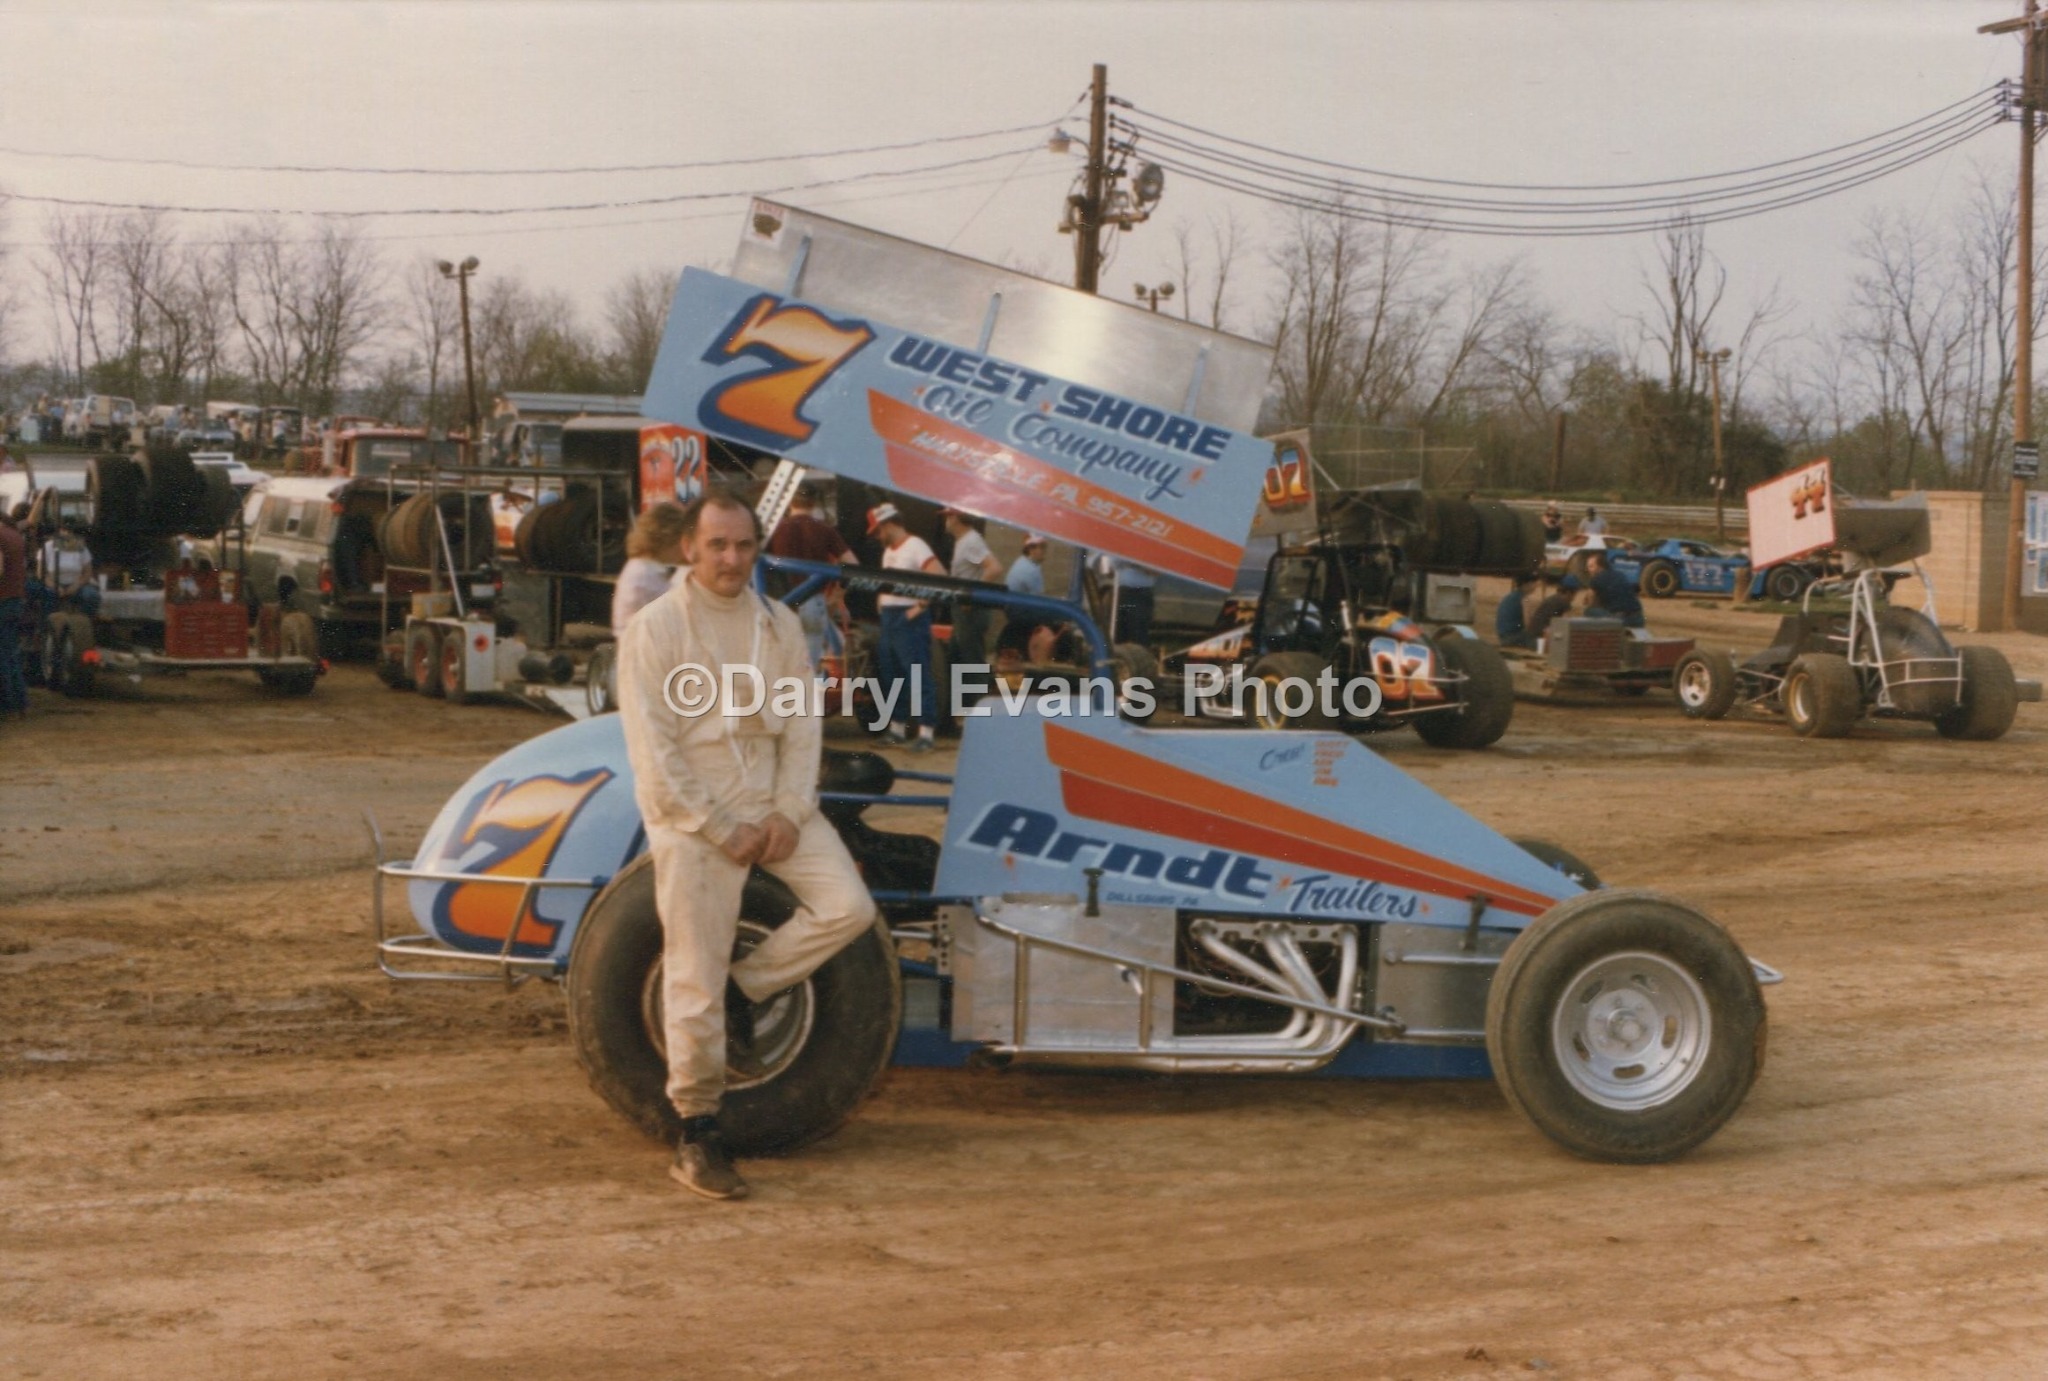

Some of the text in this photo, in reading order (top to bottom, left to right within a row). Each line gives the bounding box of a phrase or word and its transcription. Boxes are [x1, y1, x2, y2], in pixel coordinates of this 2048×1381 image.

[698, 294, 876, 451] 7
[889, 336, 1233, 461] WEST SHORE
[922, 384, 1184, 501] Oil Company
[1051, 483, 1080, 505] PA
[1368, 637, 1446, 701] 07
[432, 766, 617, 959] 7
[968, 803, 1418, 918] Arndt Trailers
